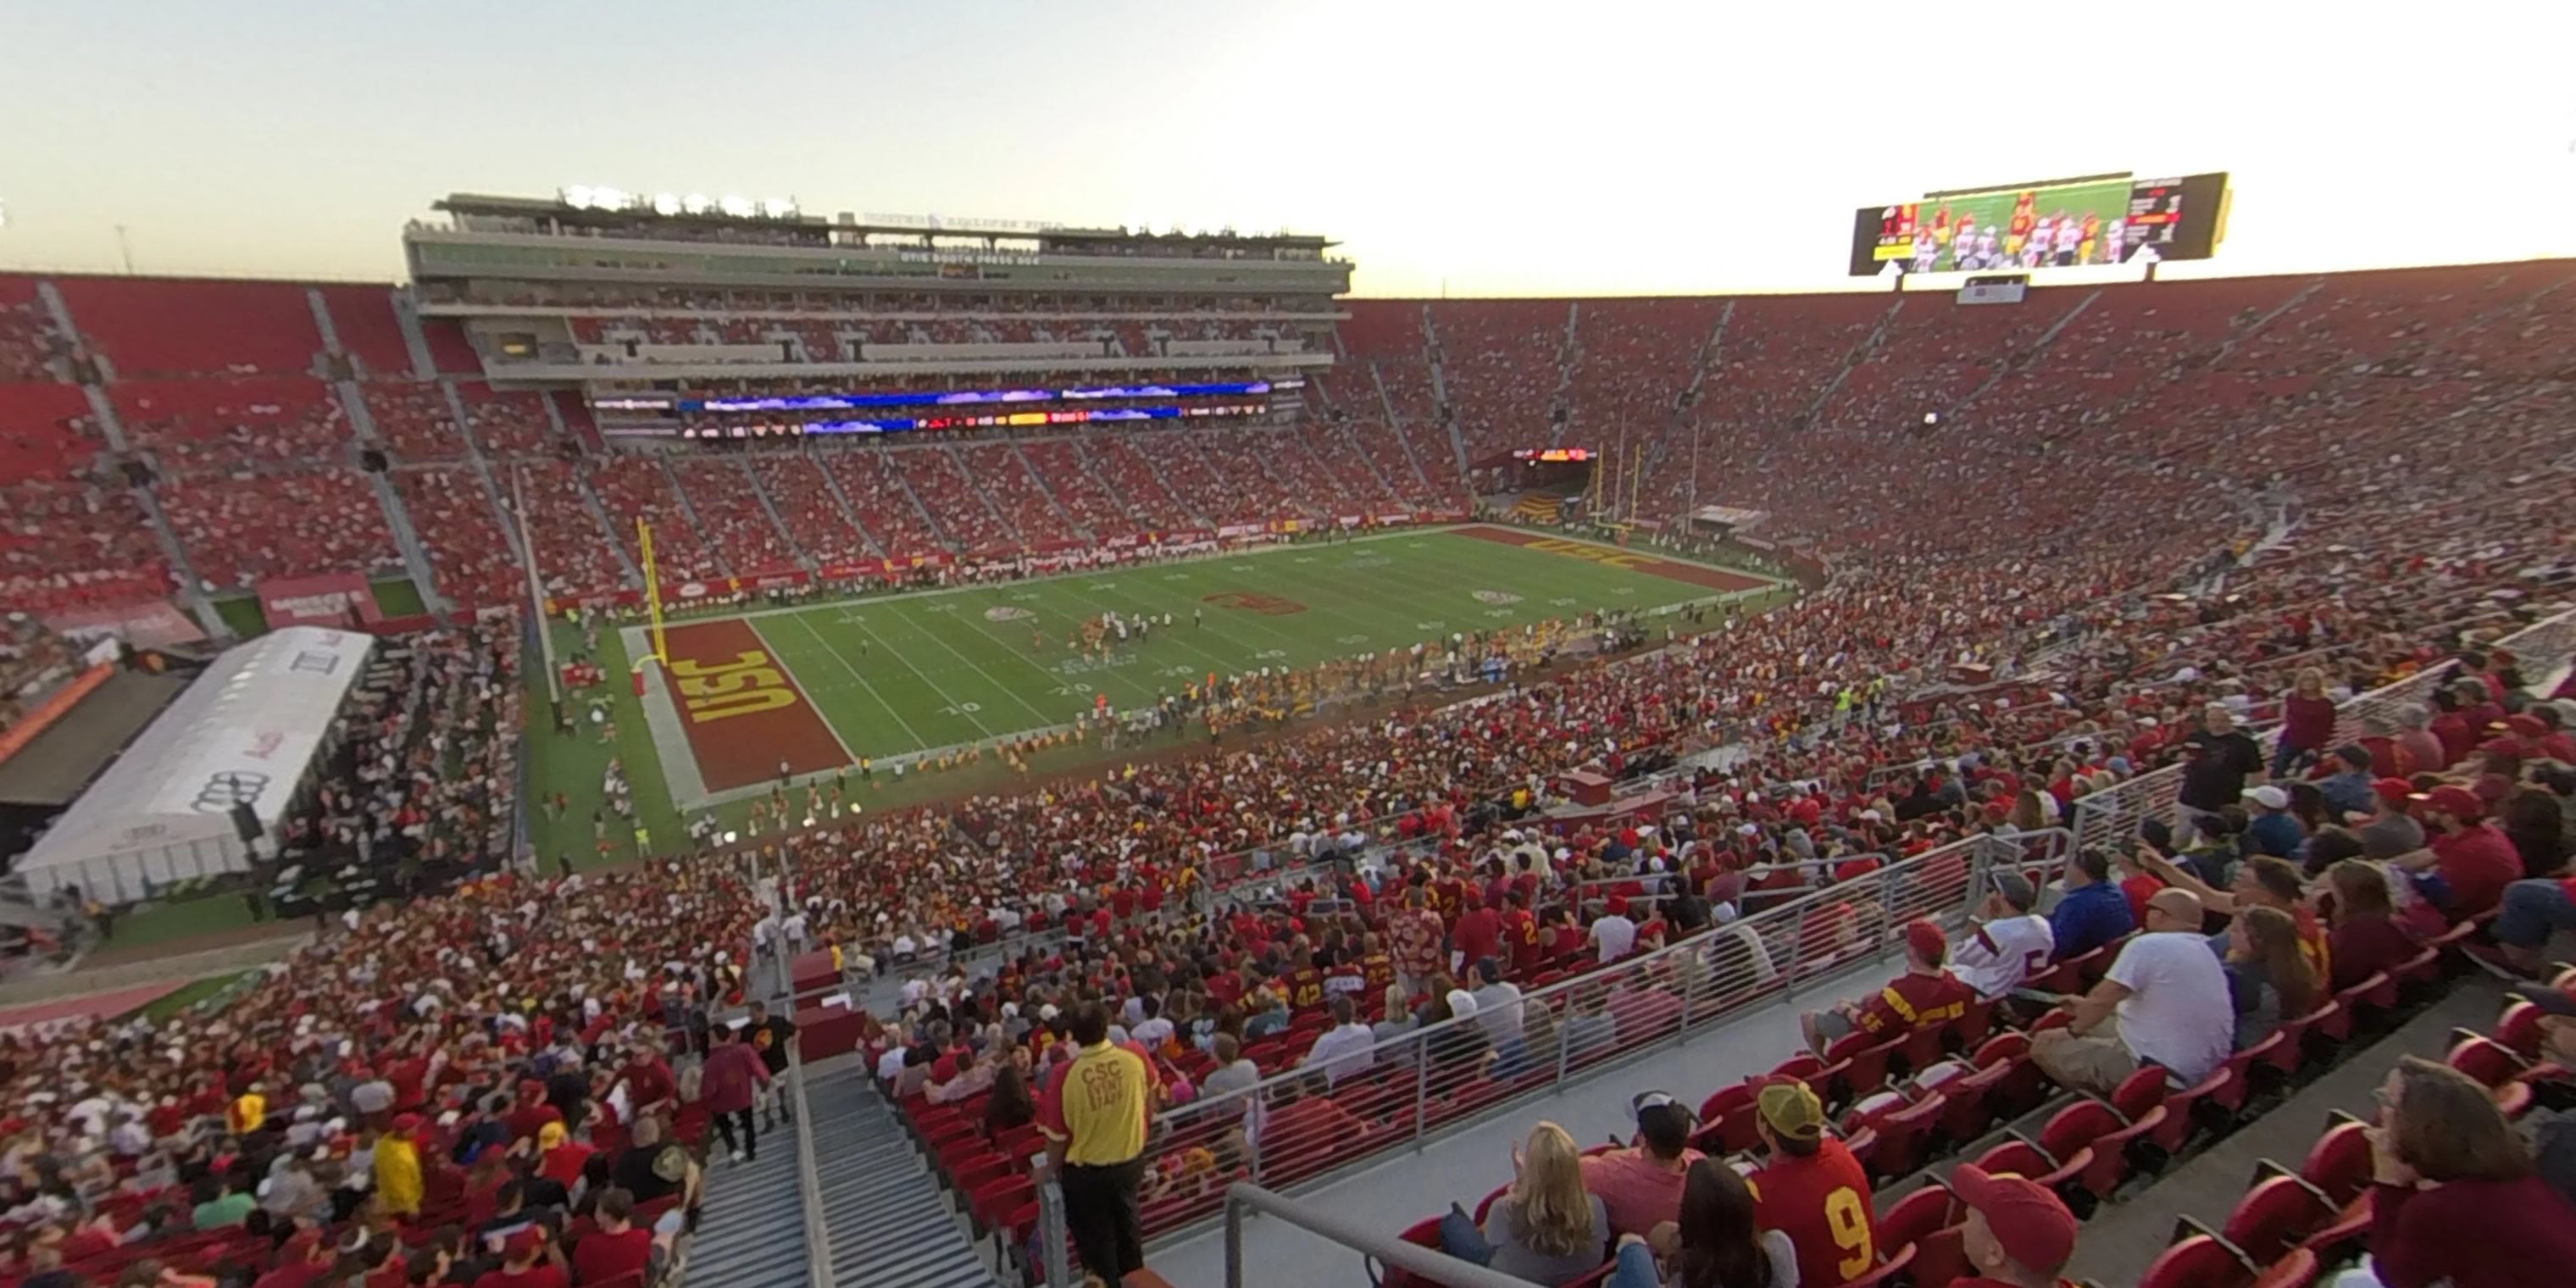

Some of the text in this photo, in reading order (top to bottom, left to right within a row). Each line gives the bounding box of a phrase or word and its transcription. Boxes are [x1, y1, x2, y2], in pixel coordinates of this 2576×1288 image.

[1523, 538, 1663, 568] USC
[669, 649, 797, 723] USC
[1295, 983, 1321, 1007] 42
[1081, 1059, 1122, 1085] CSC
[1825, 1186, 1872, 1281] 9
